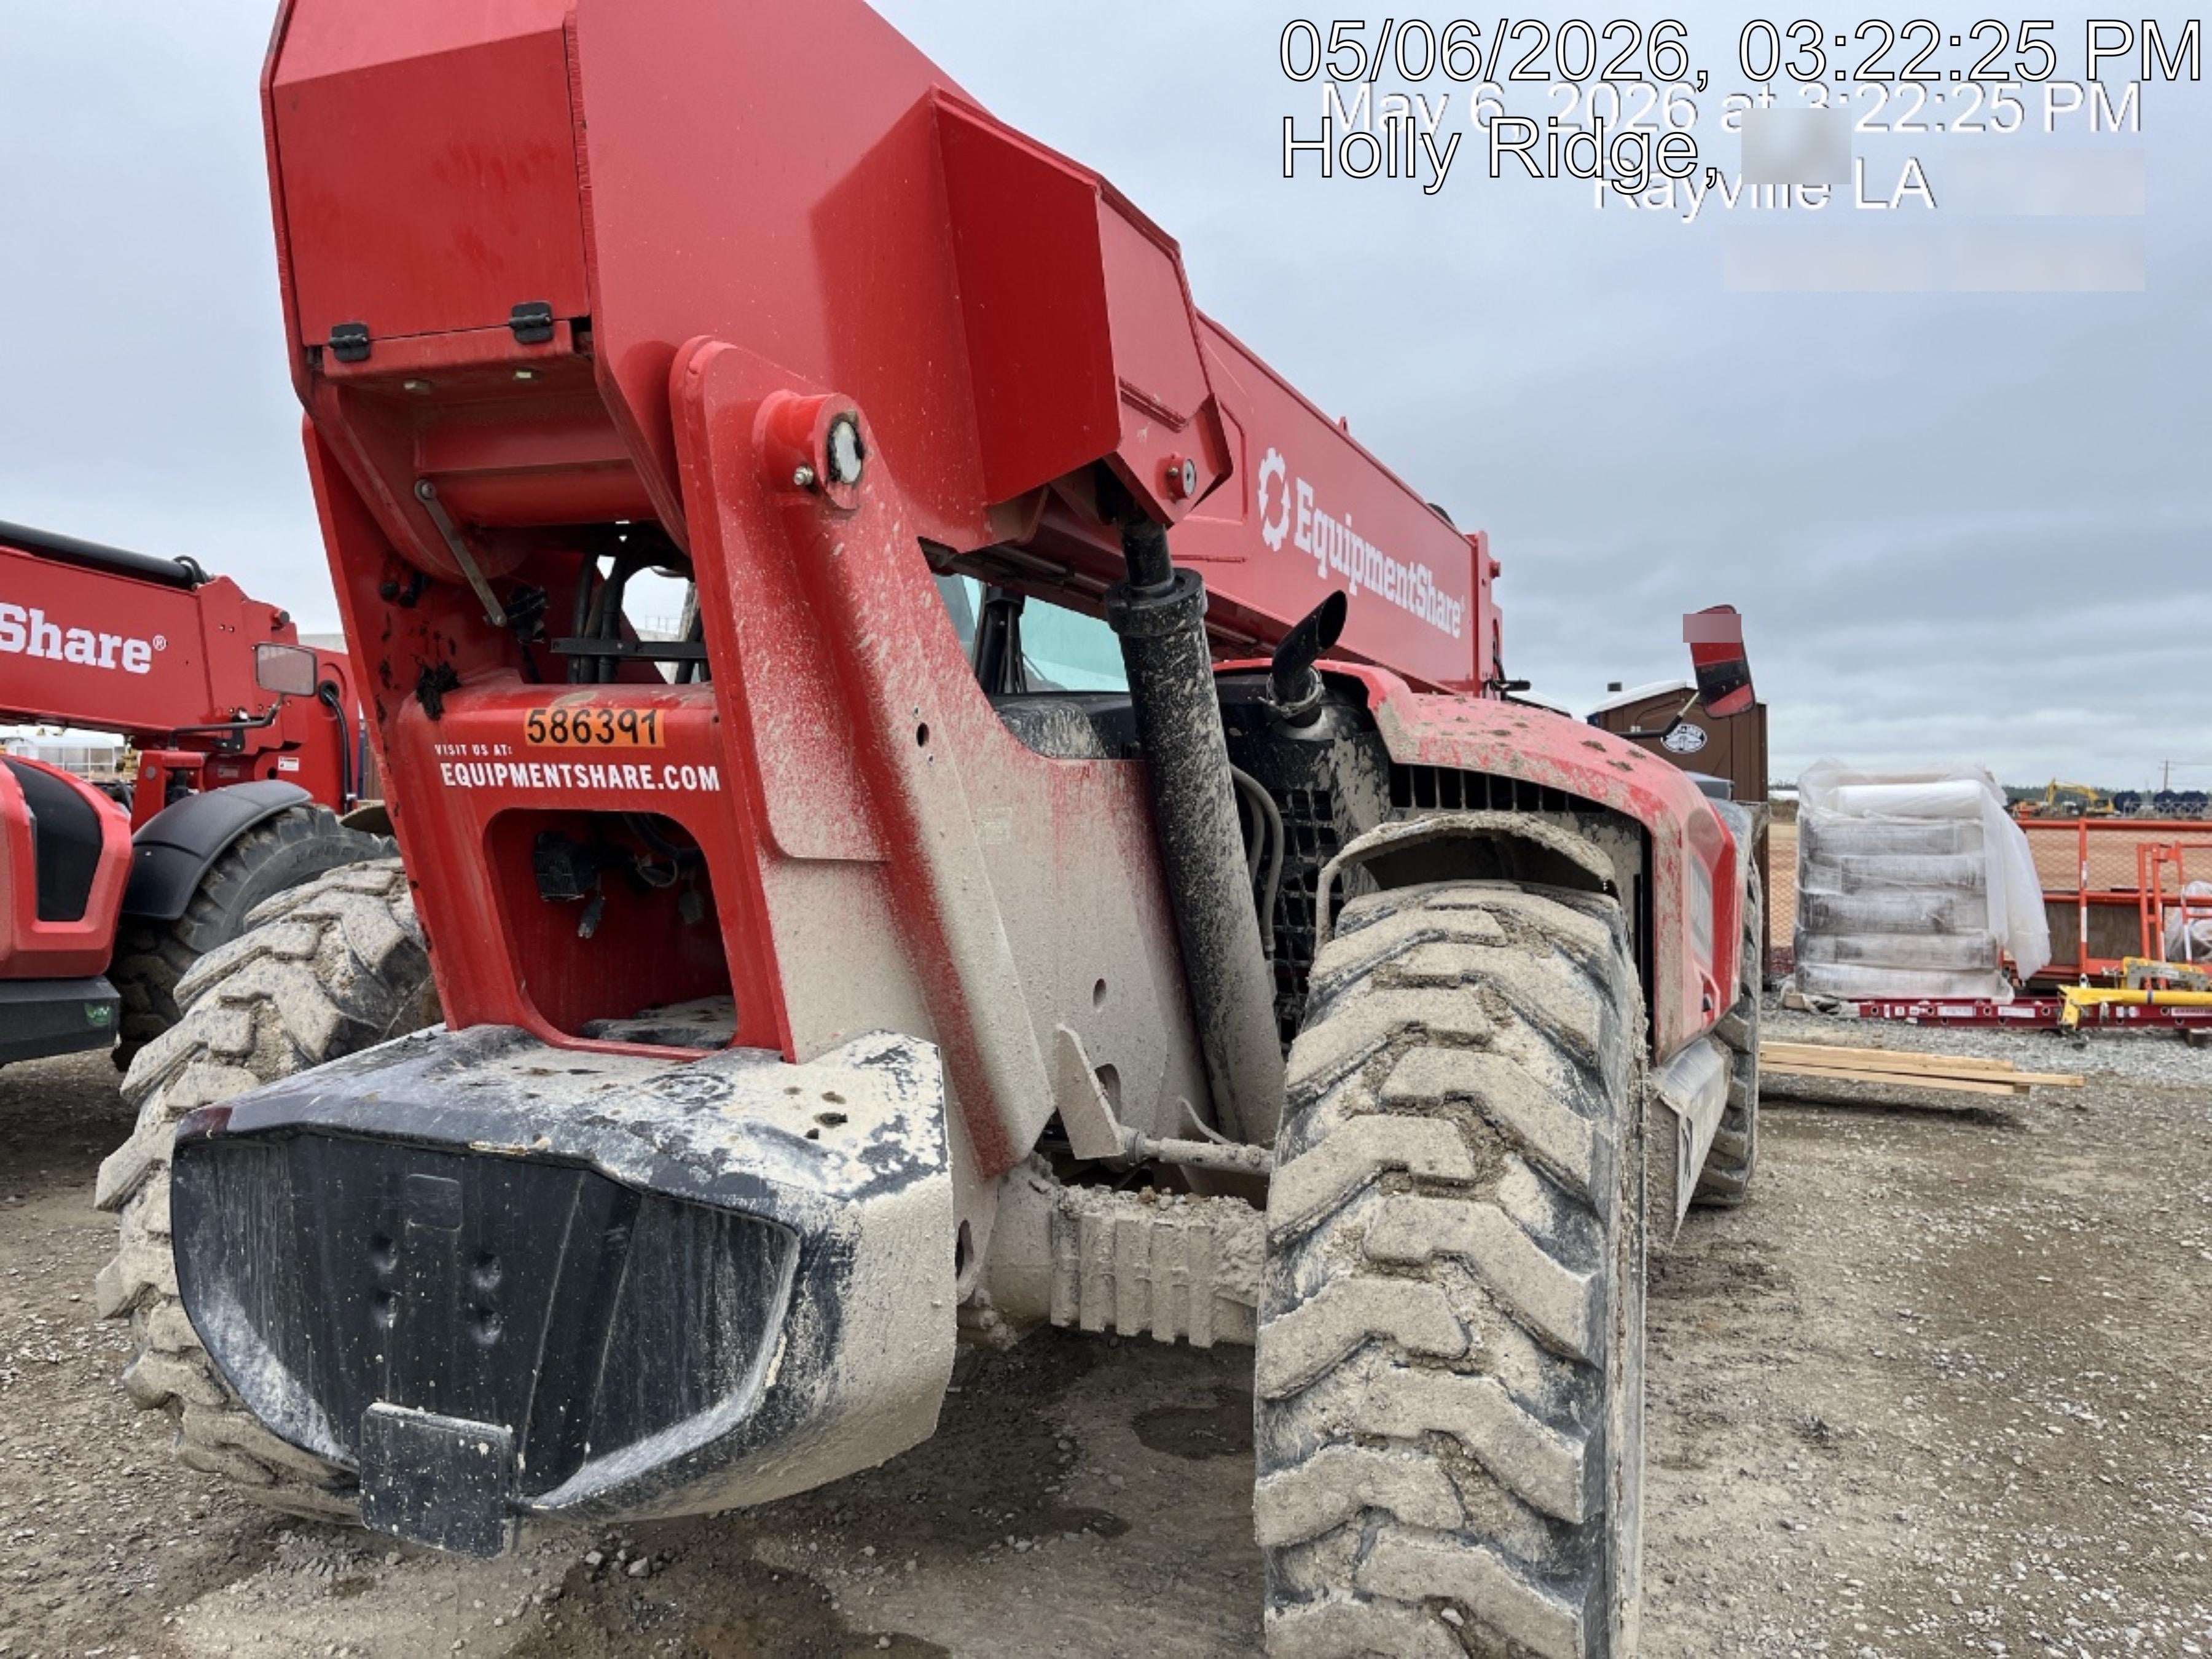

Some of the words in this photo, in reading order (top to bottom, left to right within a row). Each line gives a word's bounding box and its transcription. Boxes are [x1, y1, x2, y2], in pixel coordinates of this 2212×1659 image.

[1294, 477, 1461, 639] EquipmentShare
[527, 709, 657, 745] 586391
[434, 743, 468, 757] VISIT
[471, 743, 489, 757] US
[493, 743, 513, 757] AT:
[440, 762, 721, 791] EQUIPMENTSHARE.COM
